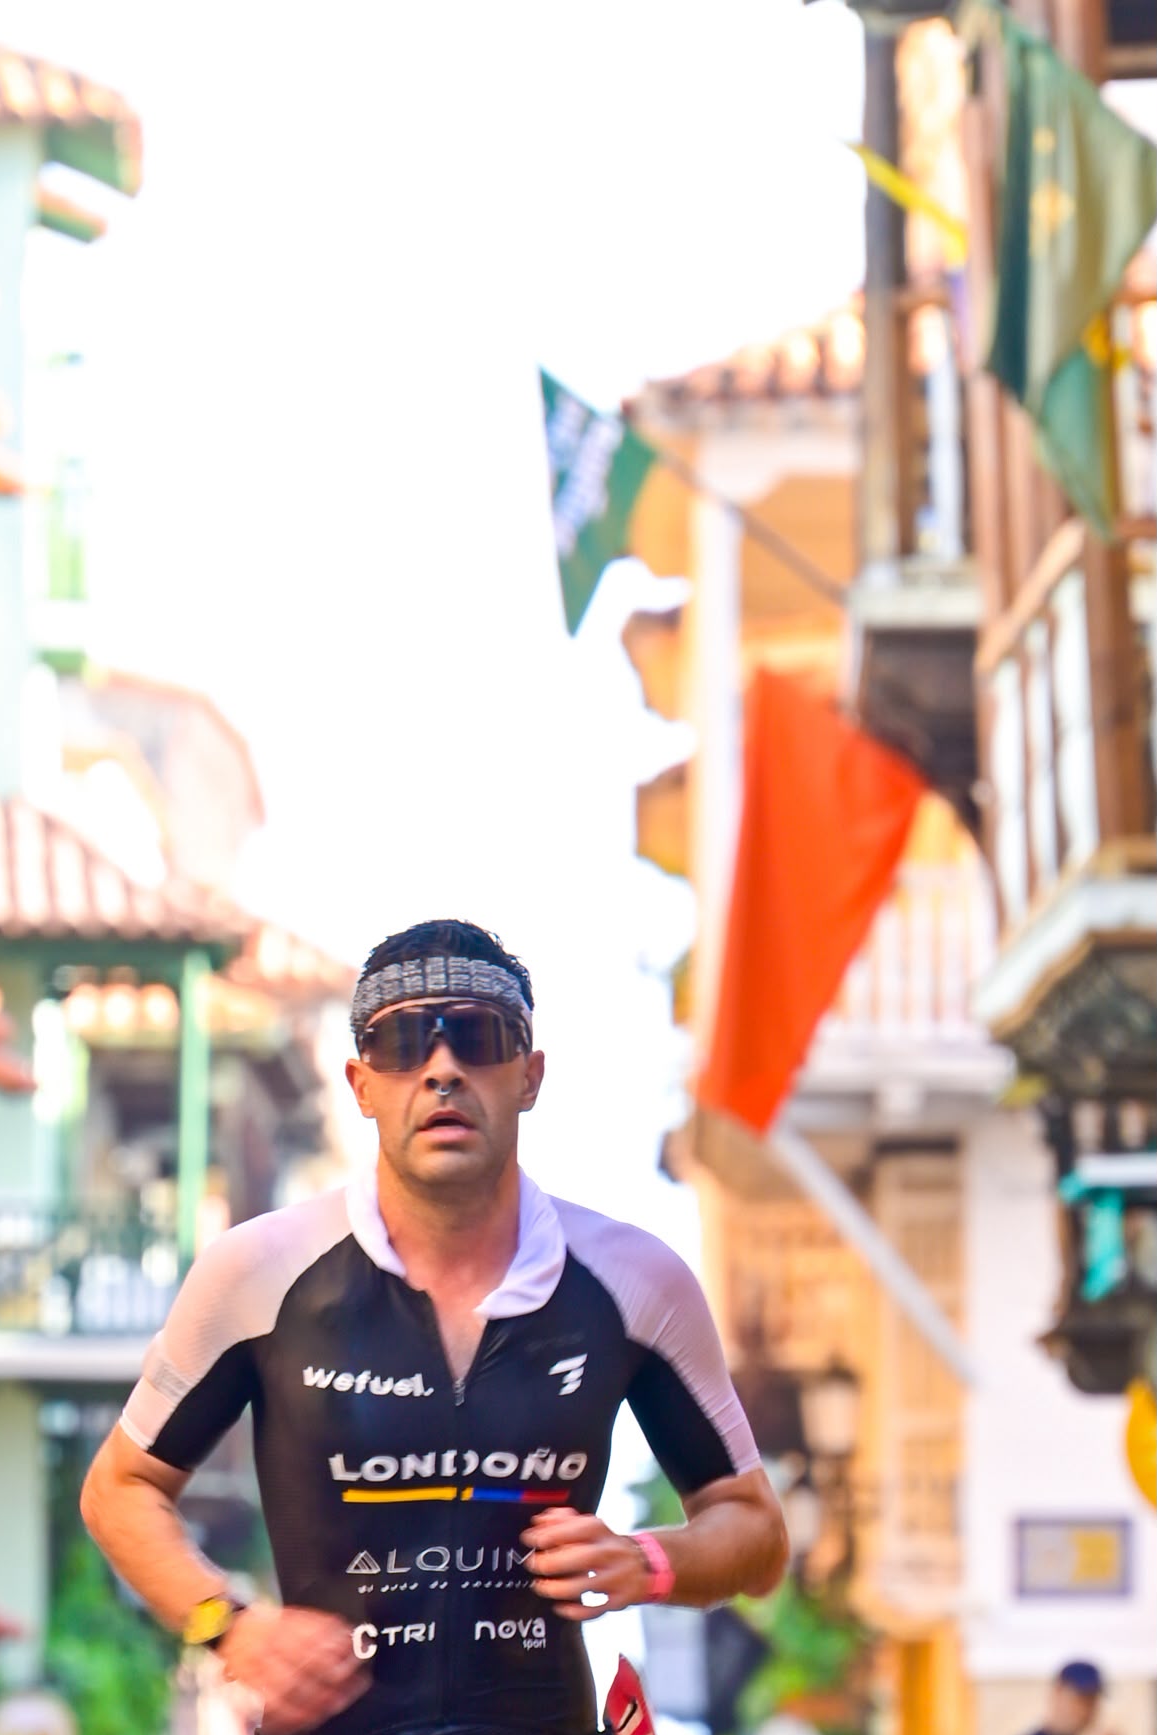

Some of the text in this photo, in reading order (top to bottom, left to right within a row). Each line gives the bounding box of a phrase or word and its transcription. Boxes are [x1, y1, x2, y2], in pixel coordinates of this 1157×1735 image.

[328, 1447, 588, 1482] LONDOÑO
[474, 1616, 546, 1640] nova
[522, 1637, 547, 1651] sport
